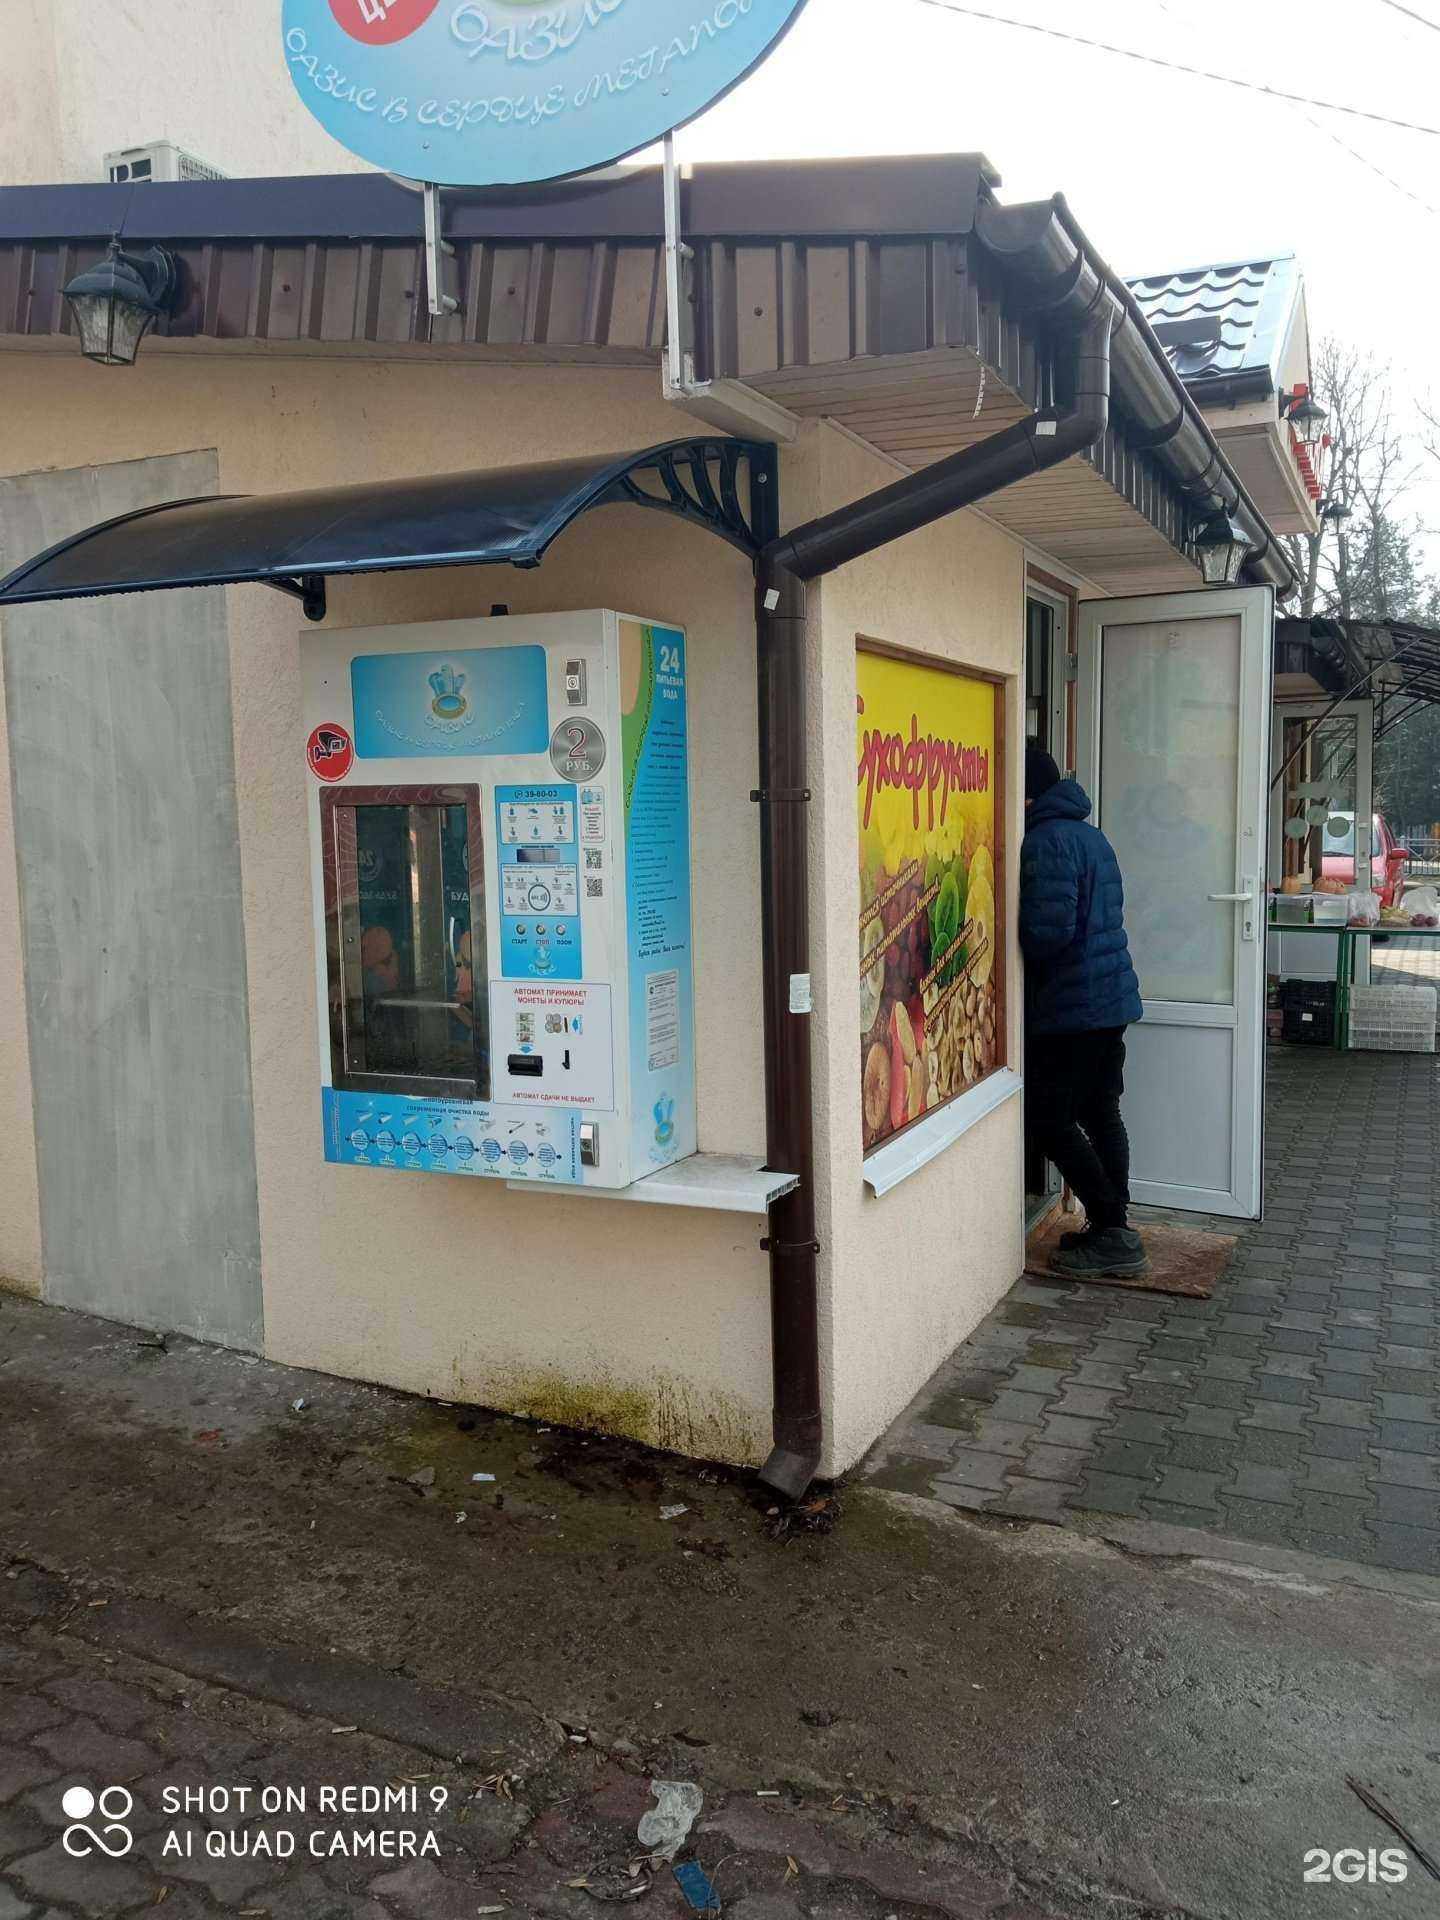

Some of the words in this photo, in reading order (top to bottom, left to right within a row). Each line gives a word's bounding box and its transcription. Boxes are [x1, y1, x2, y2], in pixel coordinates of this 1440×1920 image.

[660, 645, 681, 674] 24
[567, 726, 588, 760] 2
[514, 988, 545, 997] АВТОМАТ
[546, 989, 588, 998] ПРИНИМАЕТ
[517, 997, 547, 1005] МОНЕТЫ
